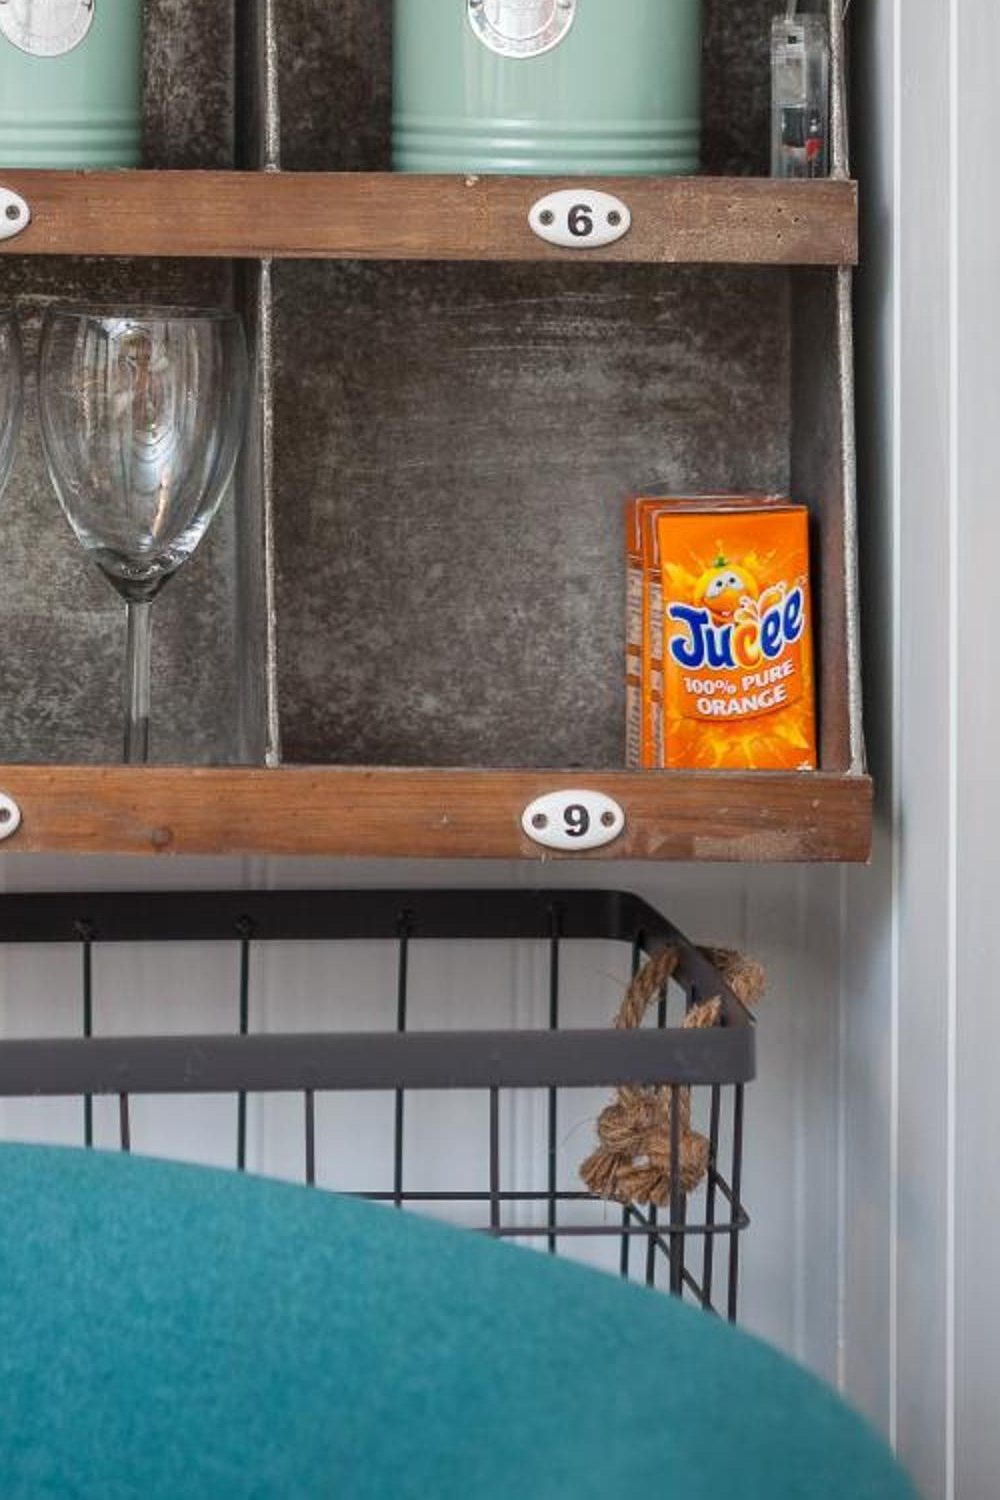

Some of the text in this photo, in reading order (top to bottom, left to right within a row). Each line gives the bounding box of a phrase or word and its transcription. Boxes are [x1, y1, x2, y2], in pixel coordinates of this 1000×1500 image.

[567, 205, 593, 236] 6
[666, 586, 806, 671] Jucee
[683, 659, 795, 695] 100% PURE
[696, 684, 788, 716] ORANGE
[563, 805, 590, 837] 9
